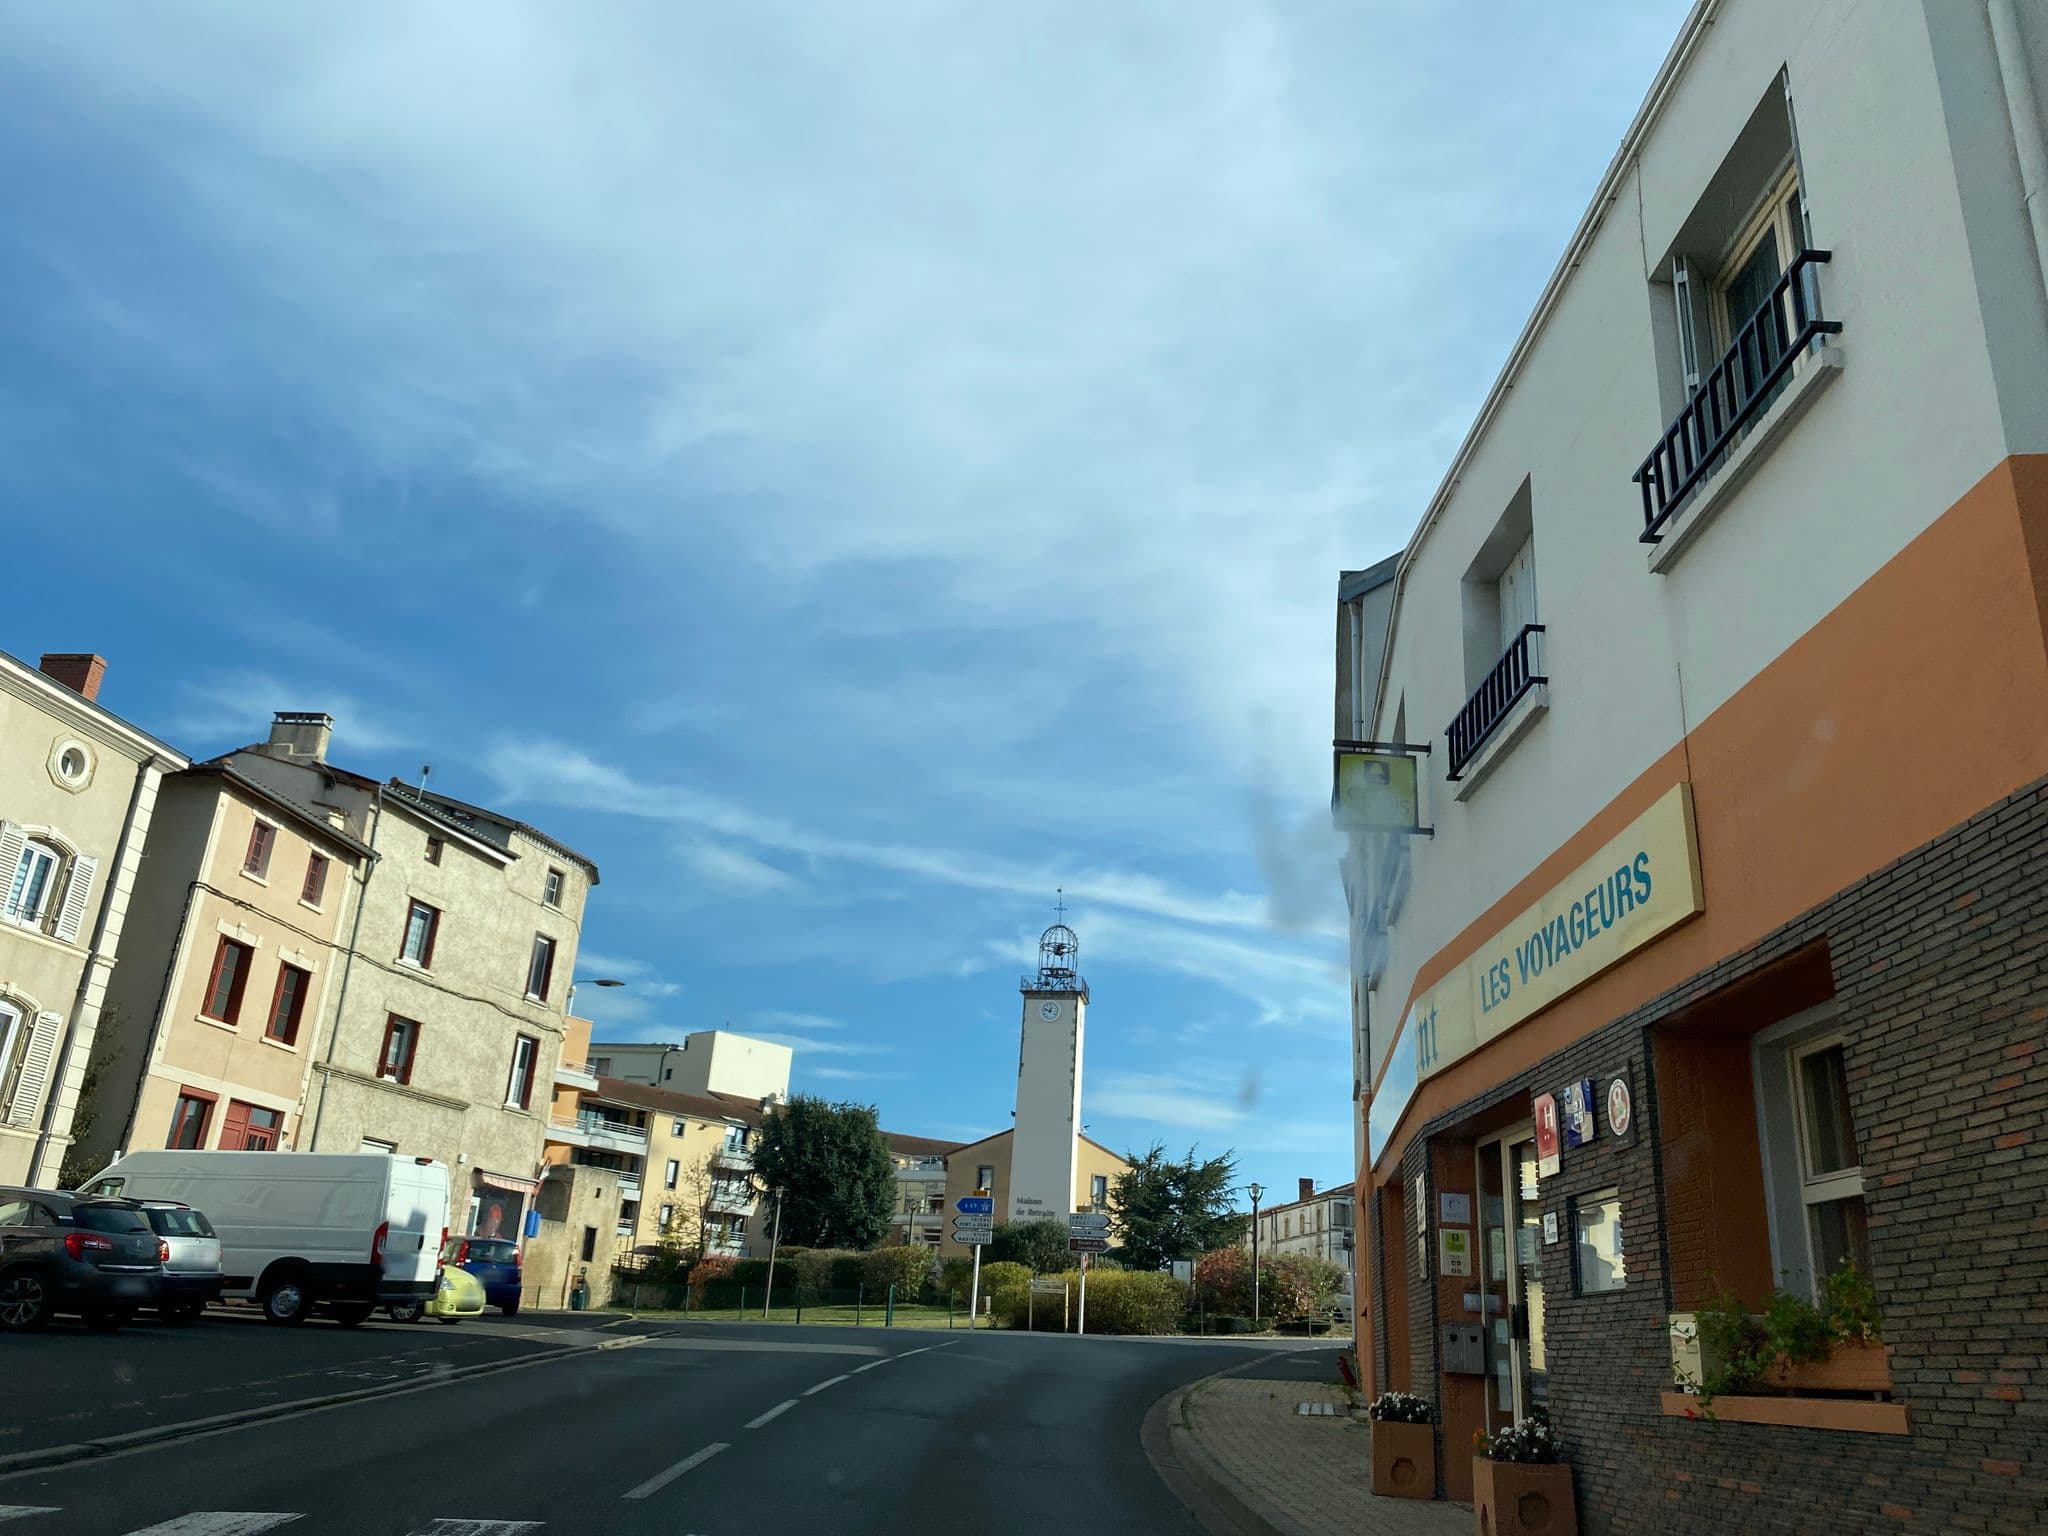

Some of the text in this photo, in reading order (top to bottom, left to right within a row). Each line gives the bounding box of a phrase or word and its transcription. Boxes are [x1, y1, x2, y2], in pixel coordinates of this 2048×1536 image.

[1481, 851, 1652, 1014] LES VOYAGEURS
[1544, 1104, 1553, 1129] H
[1016, 1197, 1042, 1205] Maison
[1016, 1207, 1056, 1216] de Retraite
